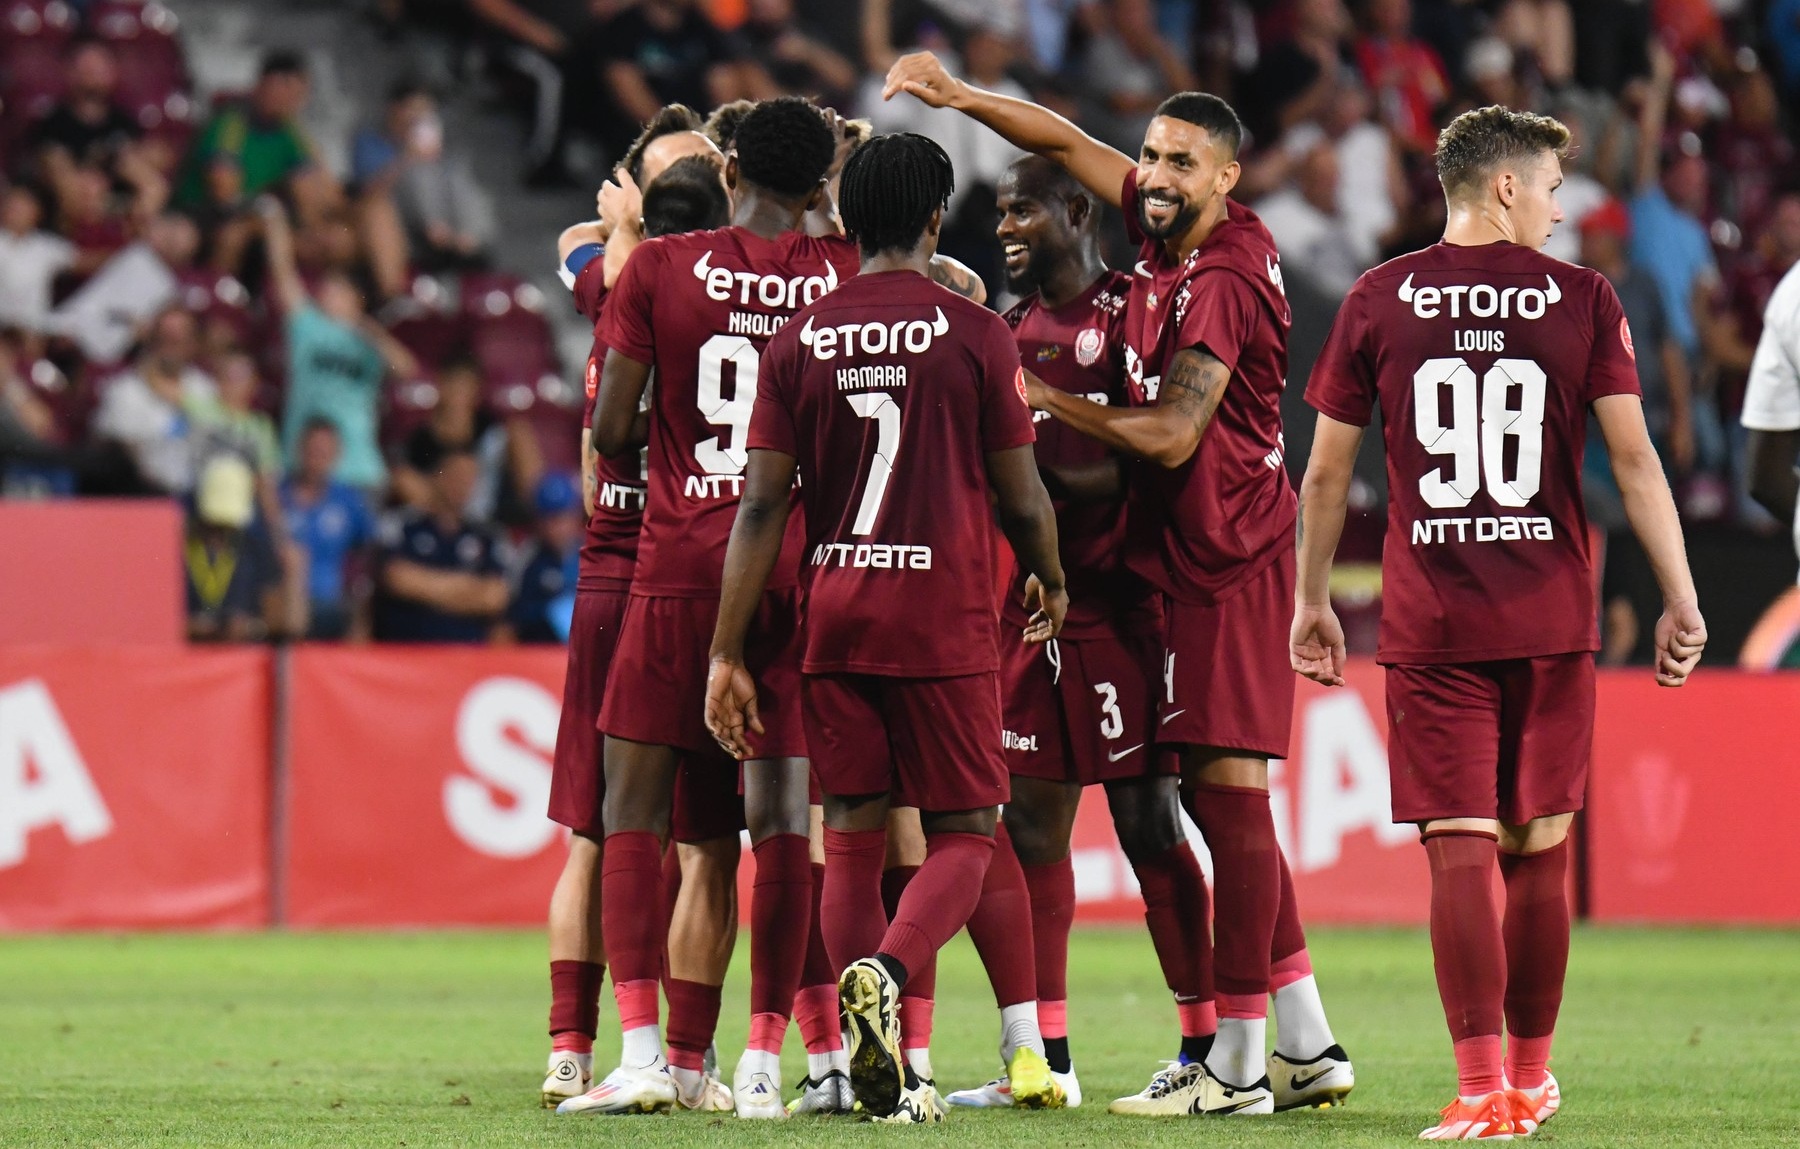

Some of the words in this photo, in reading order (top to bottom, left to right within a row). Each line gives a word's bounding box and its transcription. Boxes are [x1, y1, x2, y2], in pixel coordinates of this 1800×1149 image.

[728, 312, 790, 336] NKOLO
[1455, 330, 1504, 352] LOUIS
[837, 365, 906, 390] KAMARA
[695, 335, 759, 475] 9
[1413, 358, 1547, 508] 98
[846, 392, 900, 535] 7
[684, 475, 744, 498] NTT
[1412, 518, 1472, 544] NTT
[1094, 682, 1123, 739] 3
